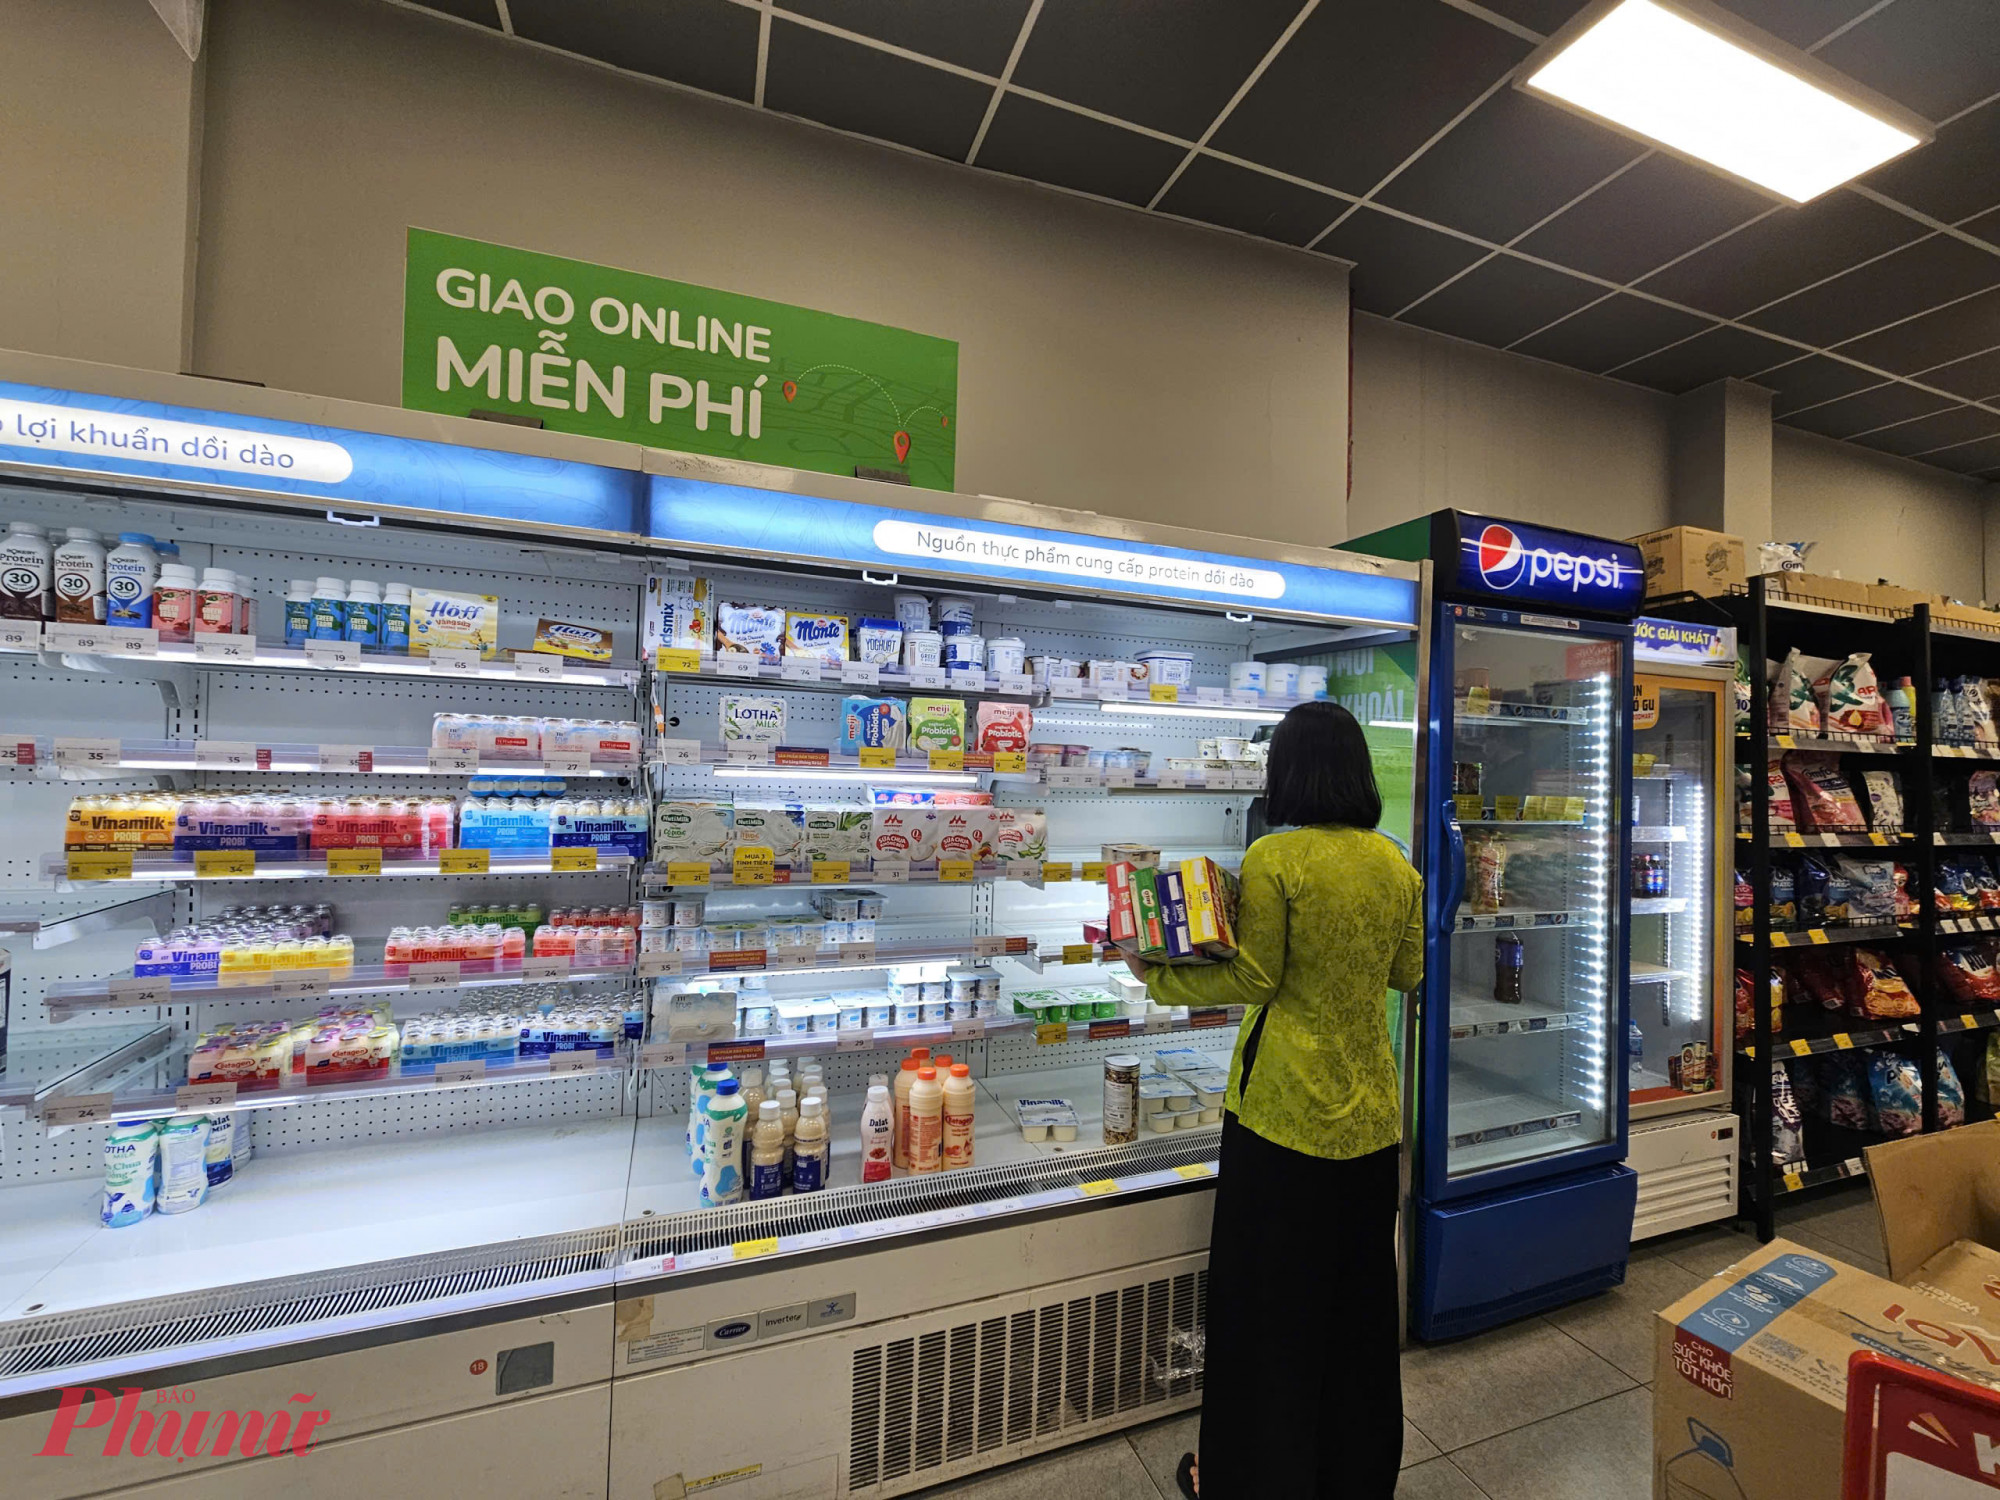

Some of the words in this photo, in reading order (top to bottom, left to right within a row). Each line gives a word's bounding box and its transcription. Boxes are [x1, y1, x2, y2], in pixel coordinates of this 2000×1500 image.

[435, 267, 575, 325] GIAO
[590, 297, 772, 363] ONLINE
[436, 329, 625, 419] MIỄN
[649, 374, 769, 439] PHÍ
[17, 414, 57, 443] lợi
[70, 421, 169, 453] khuẩn
[181, 435, 227, 461] dồi
[240, 445, 295, 469] dào
[0, 553, 44, 565] Protein
[56, 559, 94, 569] Protein
[917, 531, 976, 555] Nguồn
[983, 540, 1019, 562] thực
[1025, 545, 1070, 565] phẩm
[1076, 556, 1113, 575] cung
[1118, 557, 1144, 577] cấp
[1149, 564, 1200, 583] protein
[1204, 568, 1225, 585] dồi
[1230, 572, 1254, 589] dào
[1530, 547, 1620, 593] pepsi
[9, 573, 32, 584] 30
[63, 578, 84, 589] 30
[114, 581, 135, 591] 30
[425, 601, 484, 620] Höff
[795, 620, 840, 641] Monte
[1658, 626, 1679, 641] GIẢI
[1681, 630, 1710, 645] KHÁT
[5, 634, 22, 643] 89
[78, 639, 94, 647] 89
[125, 642, 142, 650] 89
[865, 637, 897, 653] YOGHURT
[224, 648, 239, 656] 24
[335, 654, 345, 662] 19
[454, 661, 466, 669] 65
[538, 666, 550, 674] 65
[927, 705, 950, 713] meiji
[1643, 699, 1654, 711] GU
[735, 709, 778, 720] LOTHA
[994, 709, 1014, 717] meiji
[756, 720, 778, 728] MILK
[921, 727, 957, 736] Probiotic
[988, 729, 1022, 738] Probiotic
[88, 752, 103, 760] 35
[226, 756, 240, 764] 35
[454, 761, 466, 769] 35
[92, 816, 165, 830] Vinamilk
[481, 815, 534, 826] Vinamilk
[199, 822, 268, 835] Vinamilk
[336, 820, 398, 833] Vinamilk
[575, 821, 627, 832] Vinamilk
[114, 832, 141, 842] PROBI
[220, 837, 245, 846] PROBI
[356, 834, 378, 844] PROBI
[591, 834, 611, 842] PROBI
[472, 914, 519, 924] Vinamilk
[412, 947, 466, 960] Vinamilk
[190, 961, 217, 971] PROBI
[545, 969, 556, 977] 24
[433, 975, 446, 983] 24
[301, 983, 314, 991] 24
[139, 992, 154, 1000] 24
[543, 1031, 590, 1043] Vinamilk
[556, 1042, 575, 1050] PROBI
[571, 1063, 583, 1071] 24
[207, 1097, 222, 1105] 32
[1019, 1099, 1065, 1108] Vinamilk
[78, 1110, 95, 1118] 24
[210, 1115, 230, 1126] alat
[869, 1118, 888, 1127] Dalat
[105, 1145, 136, 1153] OTHA
[720, 1325, 746, 1336] Carrier
[1691, 1341, 1713, 1357] CHO
[471, 1362, 484, 1371] 18
[1673, 1341, 1697, 1363] SỨC
[1700, 1355, 1731, 1382] KHỎE
[1674, 1355, 1699, 1379] TỐT
